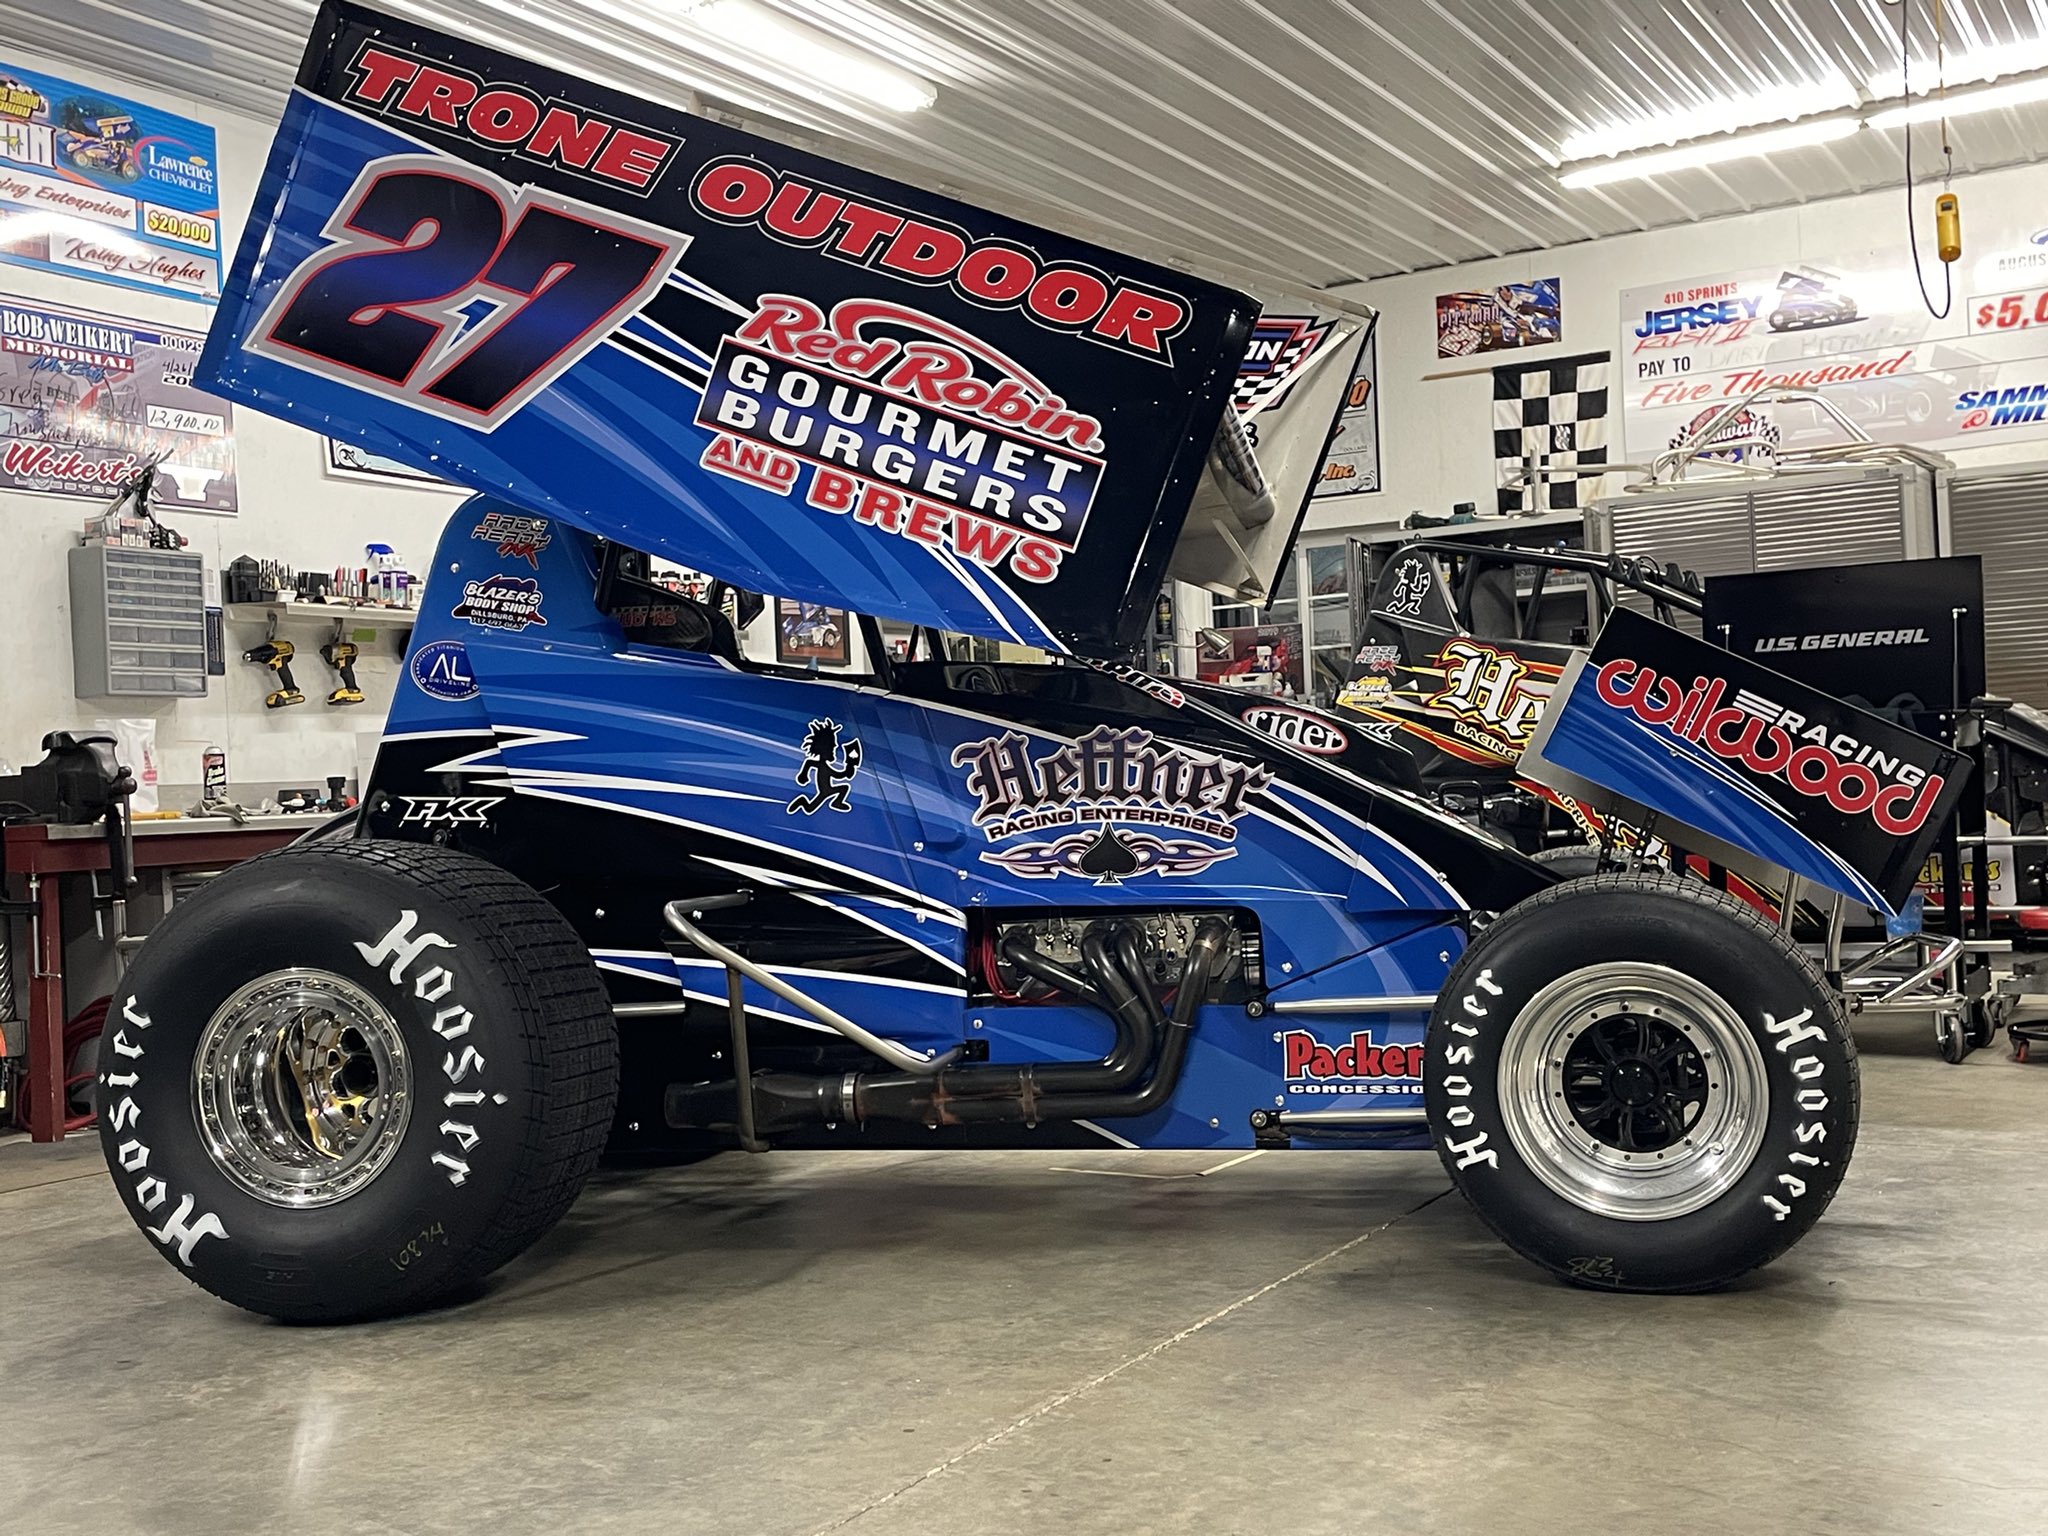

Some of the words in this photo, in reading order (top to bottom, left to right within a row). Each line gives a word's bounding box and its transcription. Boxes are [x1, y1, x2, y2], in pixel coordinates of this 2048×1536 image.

[149, 145, 213, 182] Lawrence
[149, 168, 214, 195] CHEVROLET
[35, 185, 131, 219] Enterprises
[354, 48, 672, 188] TRONE
[696, 163, 1183, 354] OUTDOOR
[149, 210, 211, 243] $20,000
[65, 237, 127, 271] Kathy
[130, 255, 205, 283] Hughes
[250, 155, 690, 430] 27
[1663, 291, 1684, 305] 410
[1687, 282, 1738, 302] SPRINTS
[3, 310, 44, 339] BOB
[46, 322, 134, 356] WEIKERT
[738, 293, 899, 377] Red
[1440, 302, 1500, 328] PITTMAN
[1634, 295, 1763, 338] JERSEY
[5, 339, 133, 371] MEMORIAL
[1638, 359, 1666, 378] PAY
[1673, 356, 1691, 373] TO
[1641, 380, 1713, 408] Five
[1723, 350, 1914, 398] Thousand
[726, 352, 1083, 495] GOURMET
[3, 441, 144, 485] Weikert's
[716, 389, 1068, 533] BURGERS
[1324, 462, 1357, 481] Inc.
[14, 476, 124, 497] LIVESTOC
[482, 512, 549, 533] RACE
[707, 438, 798, 488] AND
[806, 465, 1062, 583] BREWS
[471, 525, 552, 550] READY
[465, 596, 499, 610] BODY
[501, 600, 535, 615] SHOP
[466, 583, 542, 605] BLAZER'S
[517, 615, 528, 623] PA
[1755, 637, 1797, 653] U.S.
[1801, 628, 1930, 650] GENERAL
[429, 676, 471, 688] DRIVELINE
[430, 652, 472, 682] AL
[1249, 708, 1344, 750] rider
[1455, 723, 1520, 763] RACING
[1596, 659, 1946, 836] wilwood
[1773, 708, 1927, 788] RACING
[953, 728, 1272, 822] Heffner
[988, 808, 1075, 841] RACING
[1080, 806, 1239, 842] ENTERPRISES
[353, 909, 509, 1187] Hoosier
[1285, 1031, 1424, 1079] Packer
[1445, 968, 1505, 1172] Hoosier
[100, 995, 231, 1268] Hoosier
[1761, 1006, 1830, 1223] Hoosier
